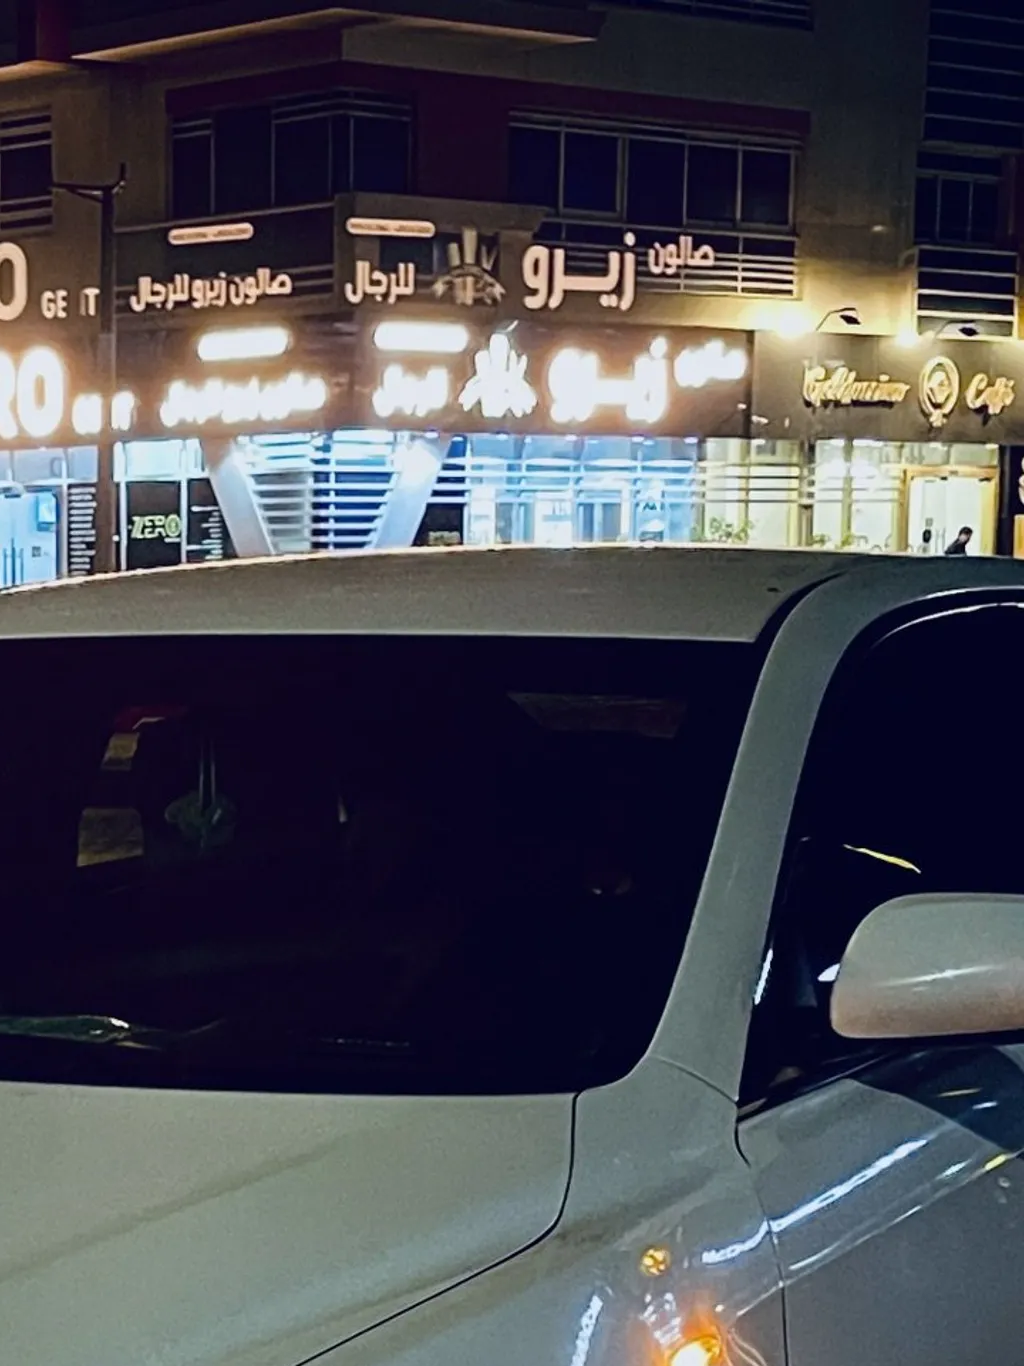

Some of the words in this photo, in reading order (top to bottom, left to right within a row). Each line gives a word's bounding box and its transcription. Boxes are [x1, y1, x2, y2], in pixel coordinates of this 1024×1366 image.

[523, 232, 636, 311] زيرو
[648, 236, 716, 275] صالون
[129, 272, 190, 312] للرجال
[191, 271, 227, 309] زيرو
[230, 267, 292, 306] صالون
[344, 260, 415, 305] للرجال
[131, 513, 181, 540] ZERO
